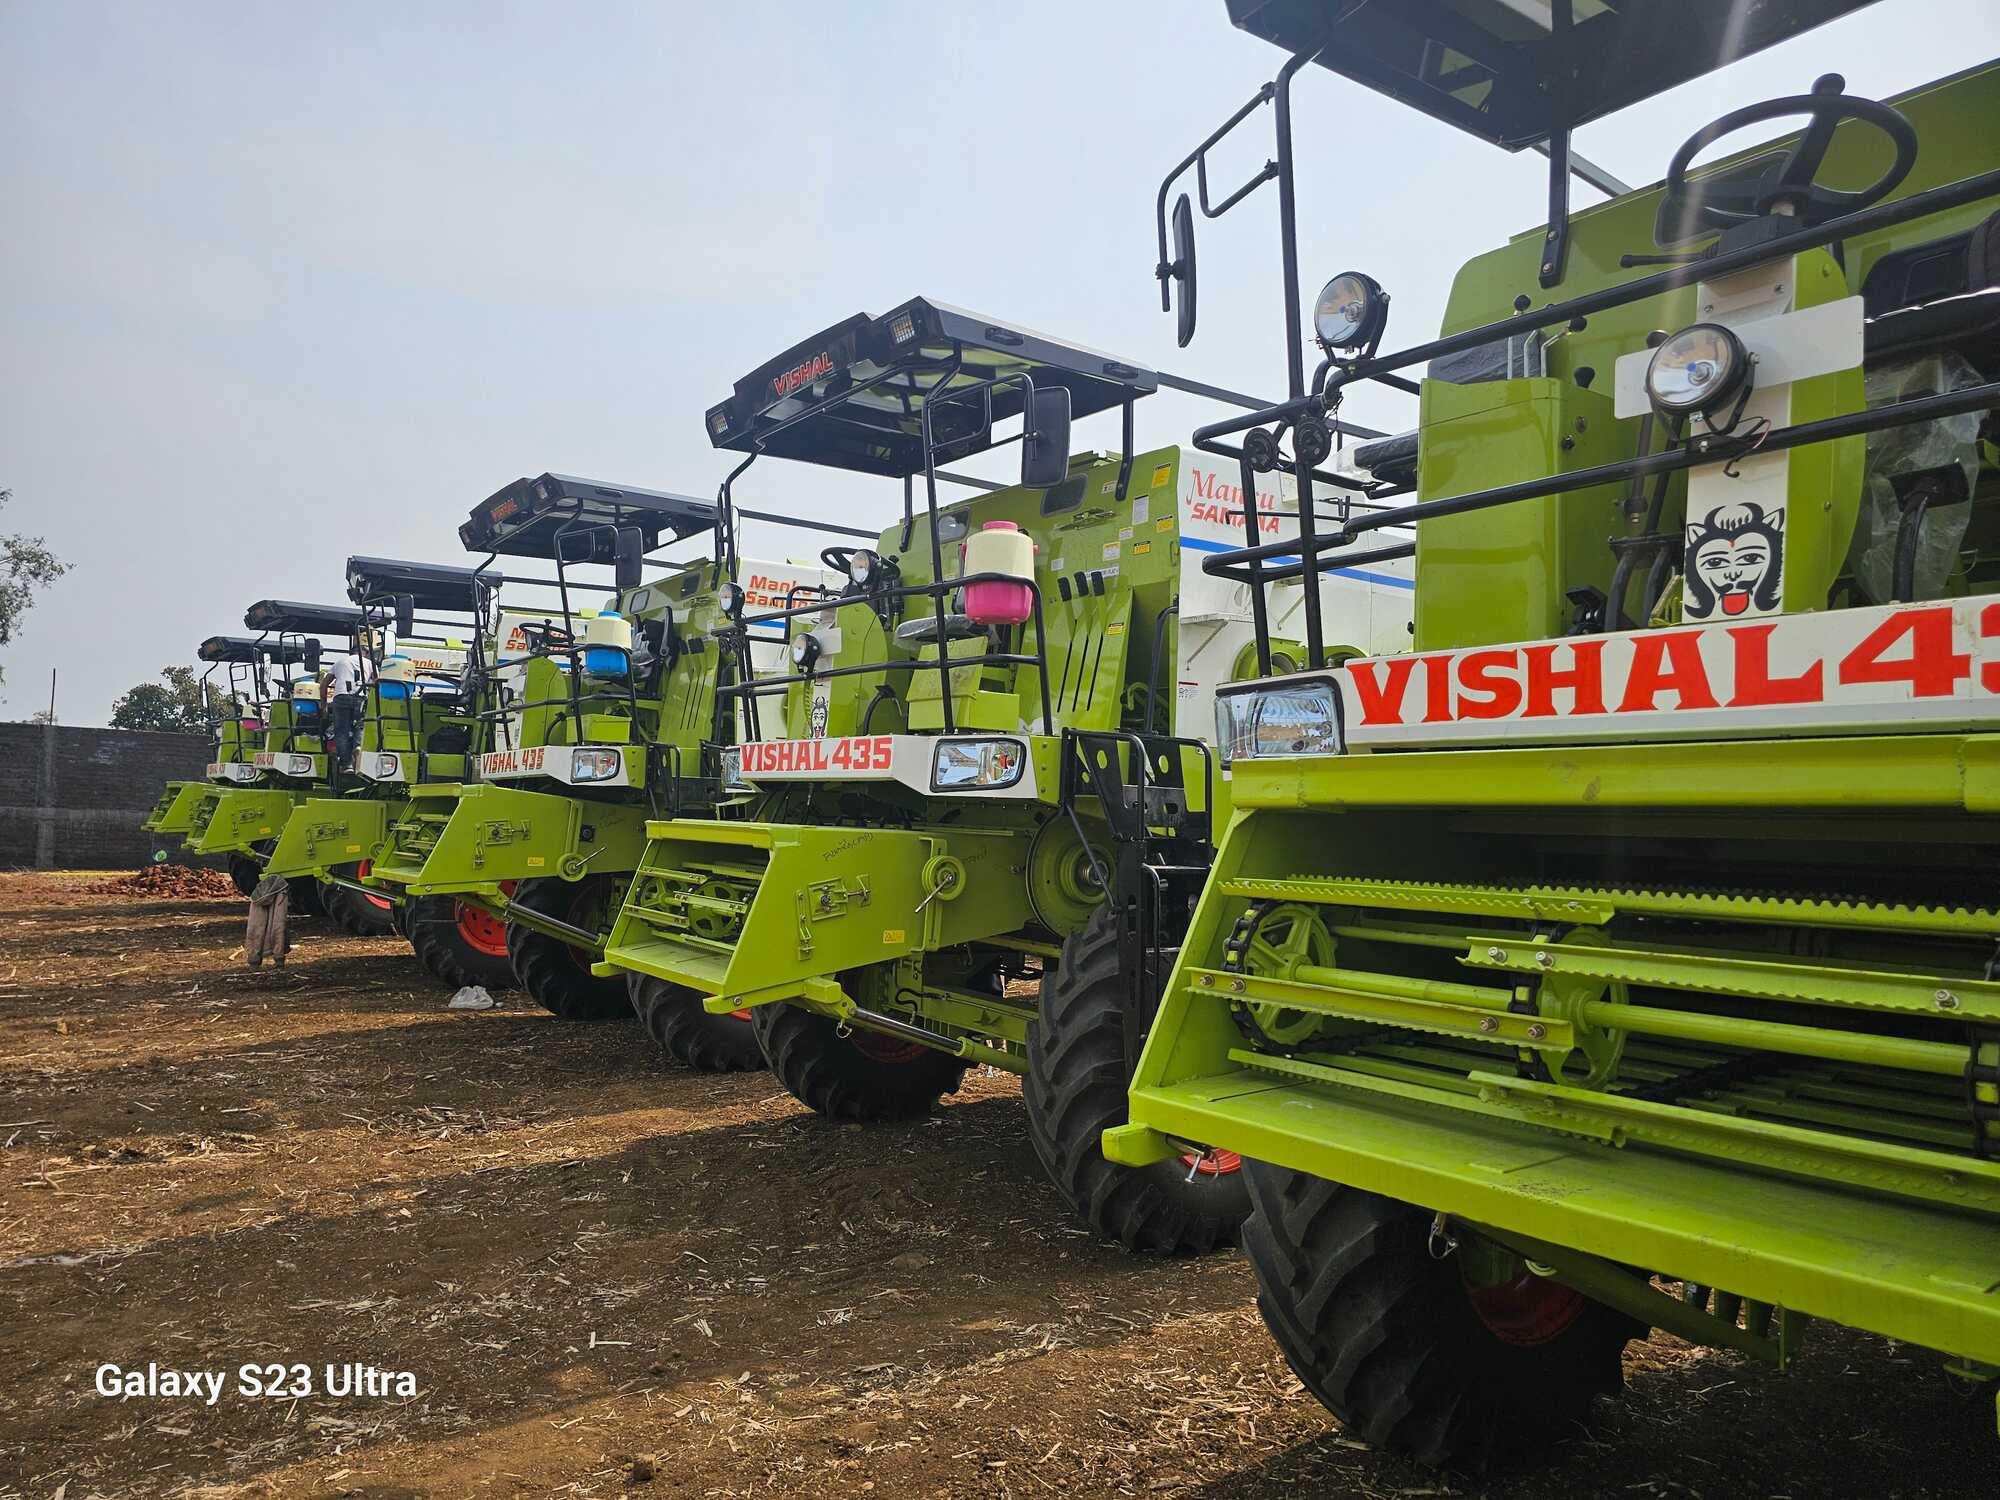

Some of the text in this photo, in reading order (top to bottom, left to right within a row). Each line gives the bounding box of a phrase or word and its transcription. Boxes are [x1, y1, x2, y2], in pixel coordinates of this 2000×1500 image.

[773, 352, 834, 396] VISHAL
[1186, 467, 1275, 511] Manu
[1346, 603, 2000, 726] VISHAL 4
[482, 747, 545, 774] VISHAL 435
[741, 737, 893, 772] VISHAL 435
